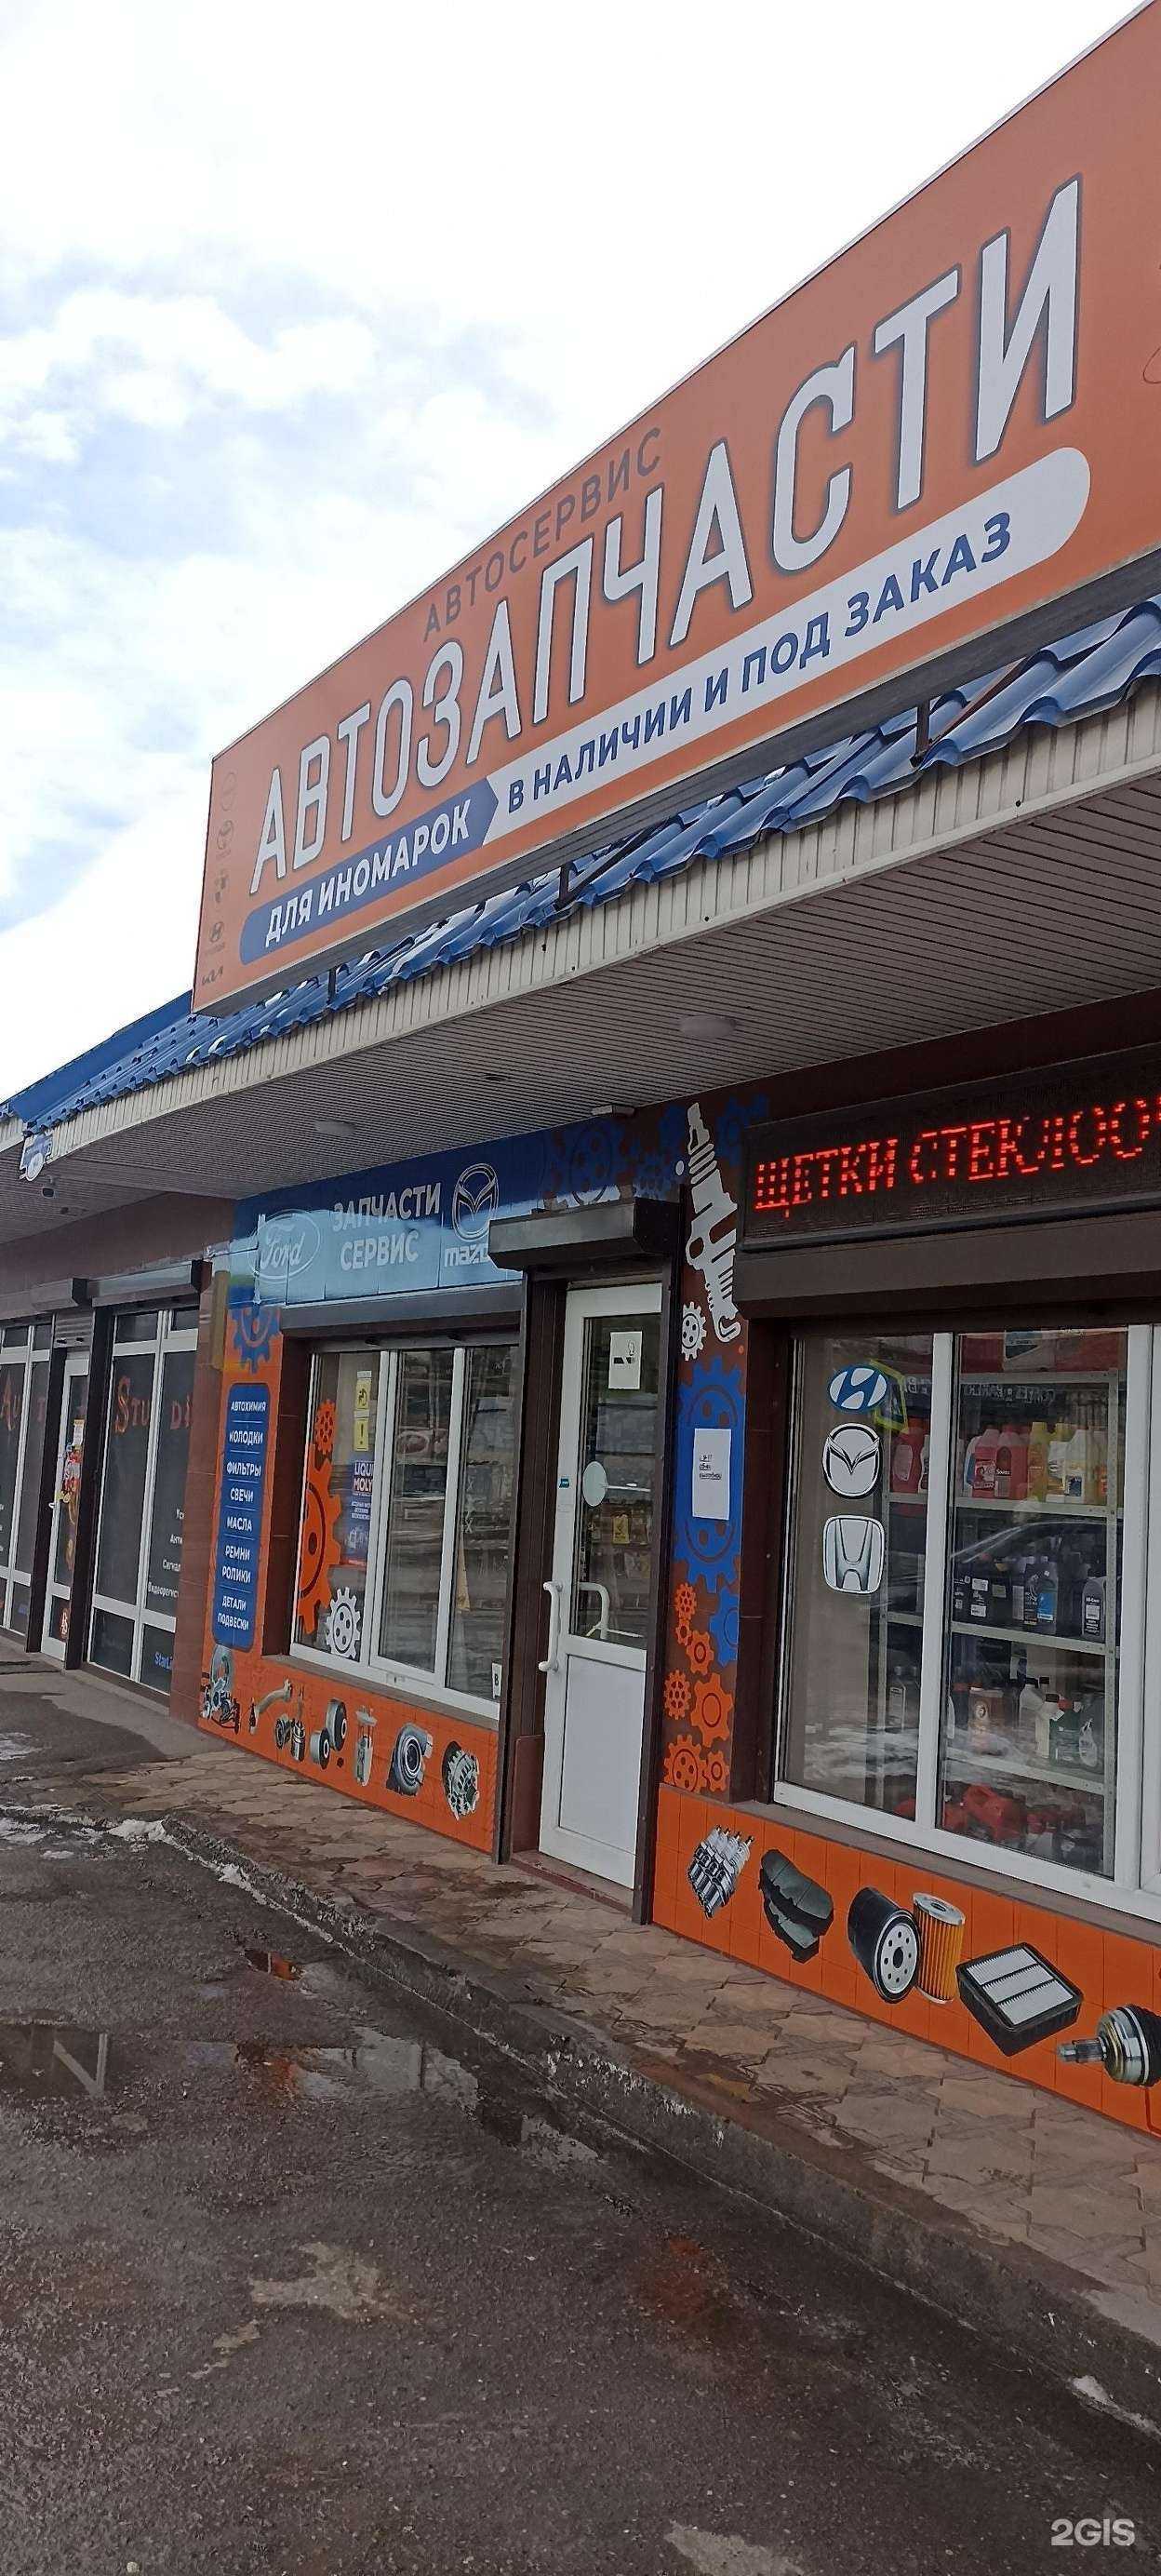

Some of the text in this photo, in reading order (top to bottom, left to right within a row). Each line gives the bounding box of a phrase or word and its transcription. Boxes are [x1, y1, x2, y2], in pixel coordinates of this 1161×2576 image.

[247, 177, 1080, 895] АВТОЗАПЧАСТИ
[423, 427, 661, 642] АВТОСЕРВИС
[265, 511, 1011, 948] ДЛЯ ИНОМАРОК В НАЛИЧИИ И ПОД ЗАКАЗ
[755, 1094, 1161, 1219] ЩЕТКИ СТЕКЛОО
[332, 1182, 441, 1232] ЗАПЧАСТИ
[260, 1222, 305, 1270] Ford
[340, 1229, 419, 1271] СЕРВИС
[231, 1401, 266, 1412] АВТОХИМИЯ
[230, 1430, 263, 1445] КОЛОДКИ
[226, 1460, 261, 1477] ФИЛЬТРЫ
[230, 1487, 254, 1502] СВЕЧИ
[353, 1478, 373, 1496] MOLY
[226, 1515, 252, 1532] МАСЛА
[225, 1545, 250, 1561] РЕМНИ
[221, 1565, 251, 1583] РОЛИКИ
[222, 1595, 247, 1611] ДЕТАЛИ
[217, 1613, 249, 1630] ПОДВЕСКИ
